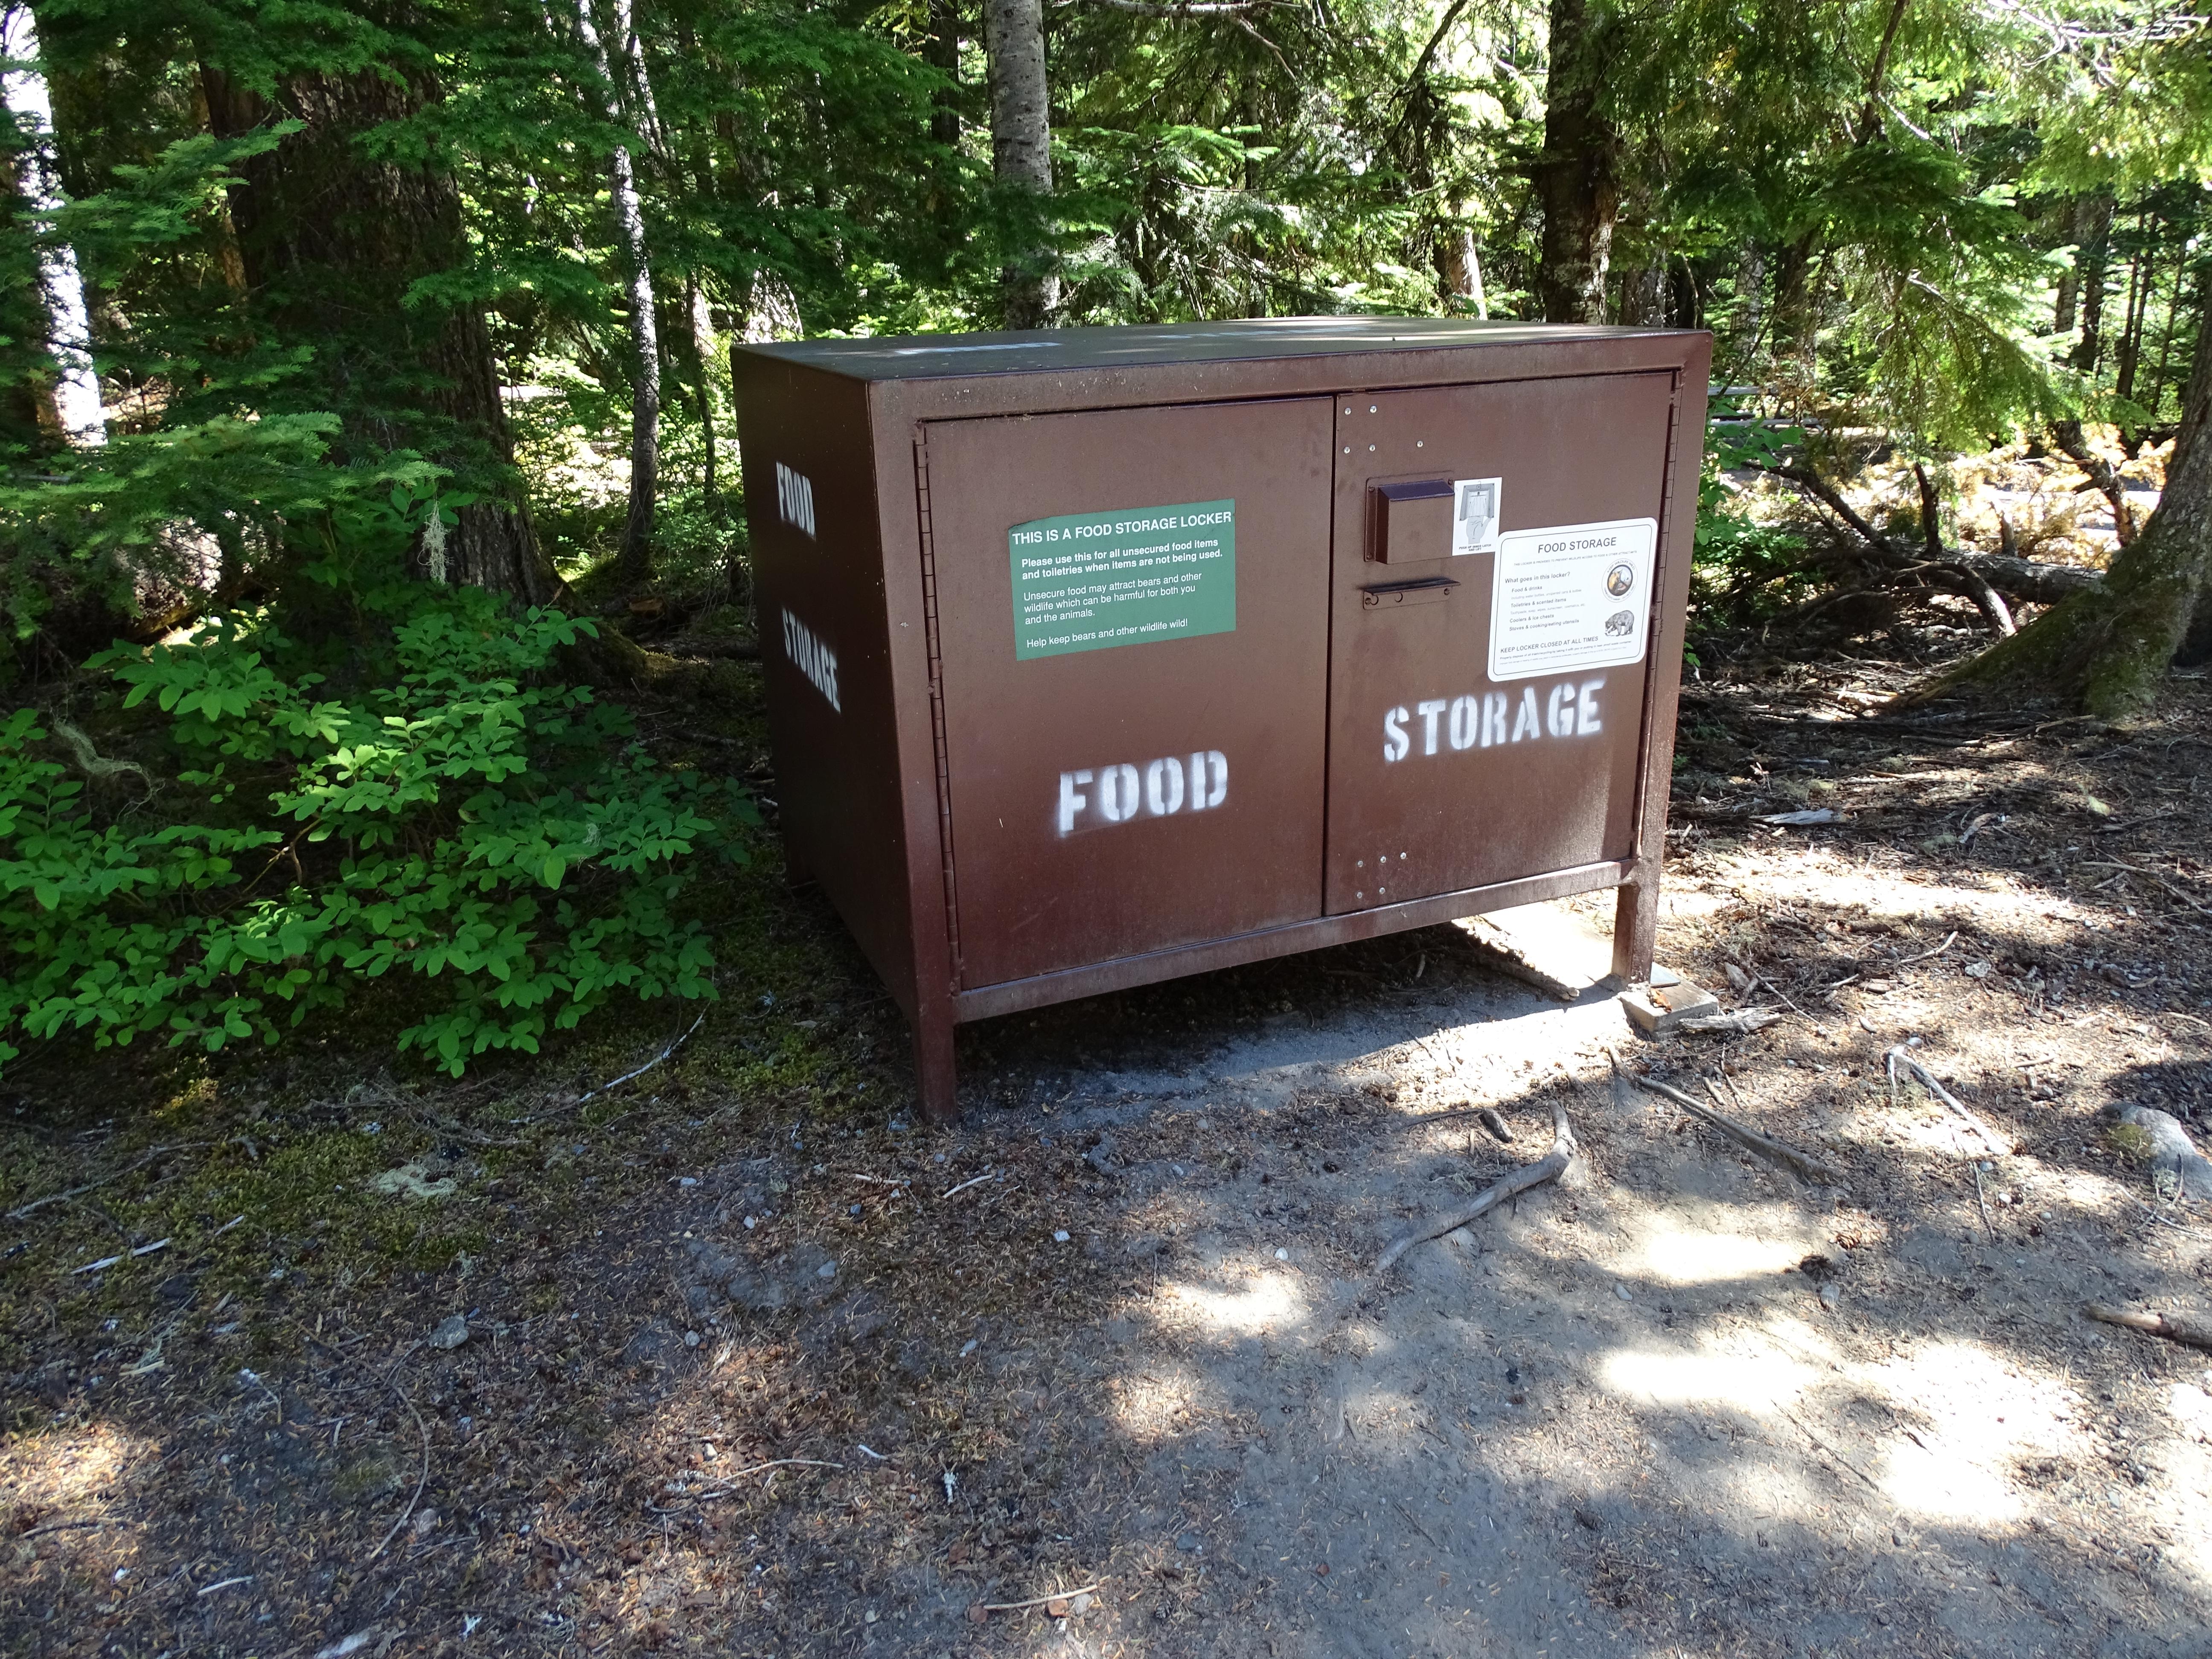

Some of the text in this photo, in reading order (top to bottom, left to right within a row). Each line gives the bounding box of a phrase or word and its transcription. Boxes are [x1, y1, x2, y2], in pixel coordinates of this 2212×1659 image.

[776, 460, 816, 541] FOOD
[1013, 511, 1231, 544] THIS IS A FOOD STORAGE LOCKER
[1022, 539, 1218, 568] Please use this for all unsecured food items
[1538, 537, 1616, 553] FOOD STORAGE
[1022, 548, 1222, 580] and toiletries when items are not being used.
[1024, 572, 1202, 601] Unsecure food may attract bears and other
[1024, 601, 1054, 613] wildlife
[1056, 598, 1080, 608] which
[1100, 594, 1111, 603] be
[1114, 589, 1145, 601] harmful
[1147, 589, 1158, 597] for
[1160, 586, 1178, 596] both
[1181, 585, 1195, 595] you
[1025, 608, 1095, 625] and the animals.
[1027, 618, 1187, 648] Help keep bears and other wildlife wild!
[782, 606, 841, 714] STORAGE
[1384, 679, 1605, 763] STORAGE
[1059, 750, 1228, 832] FOOD
